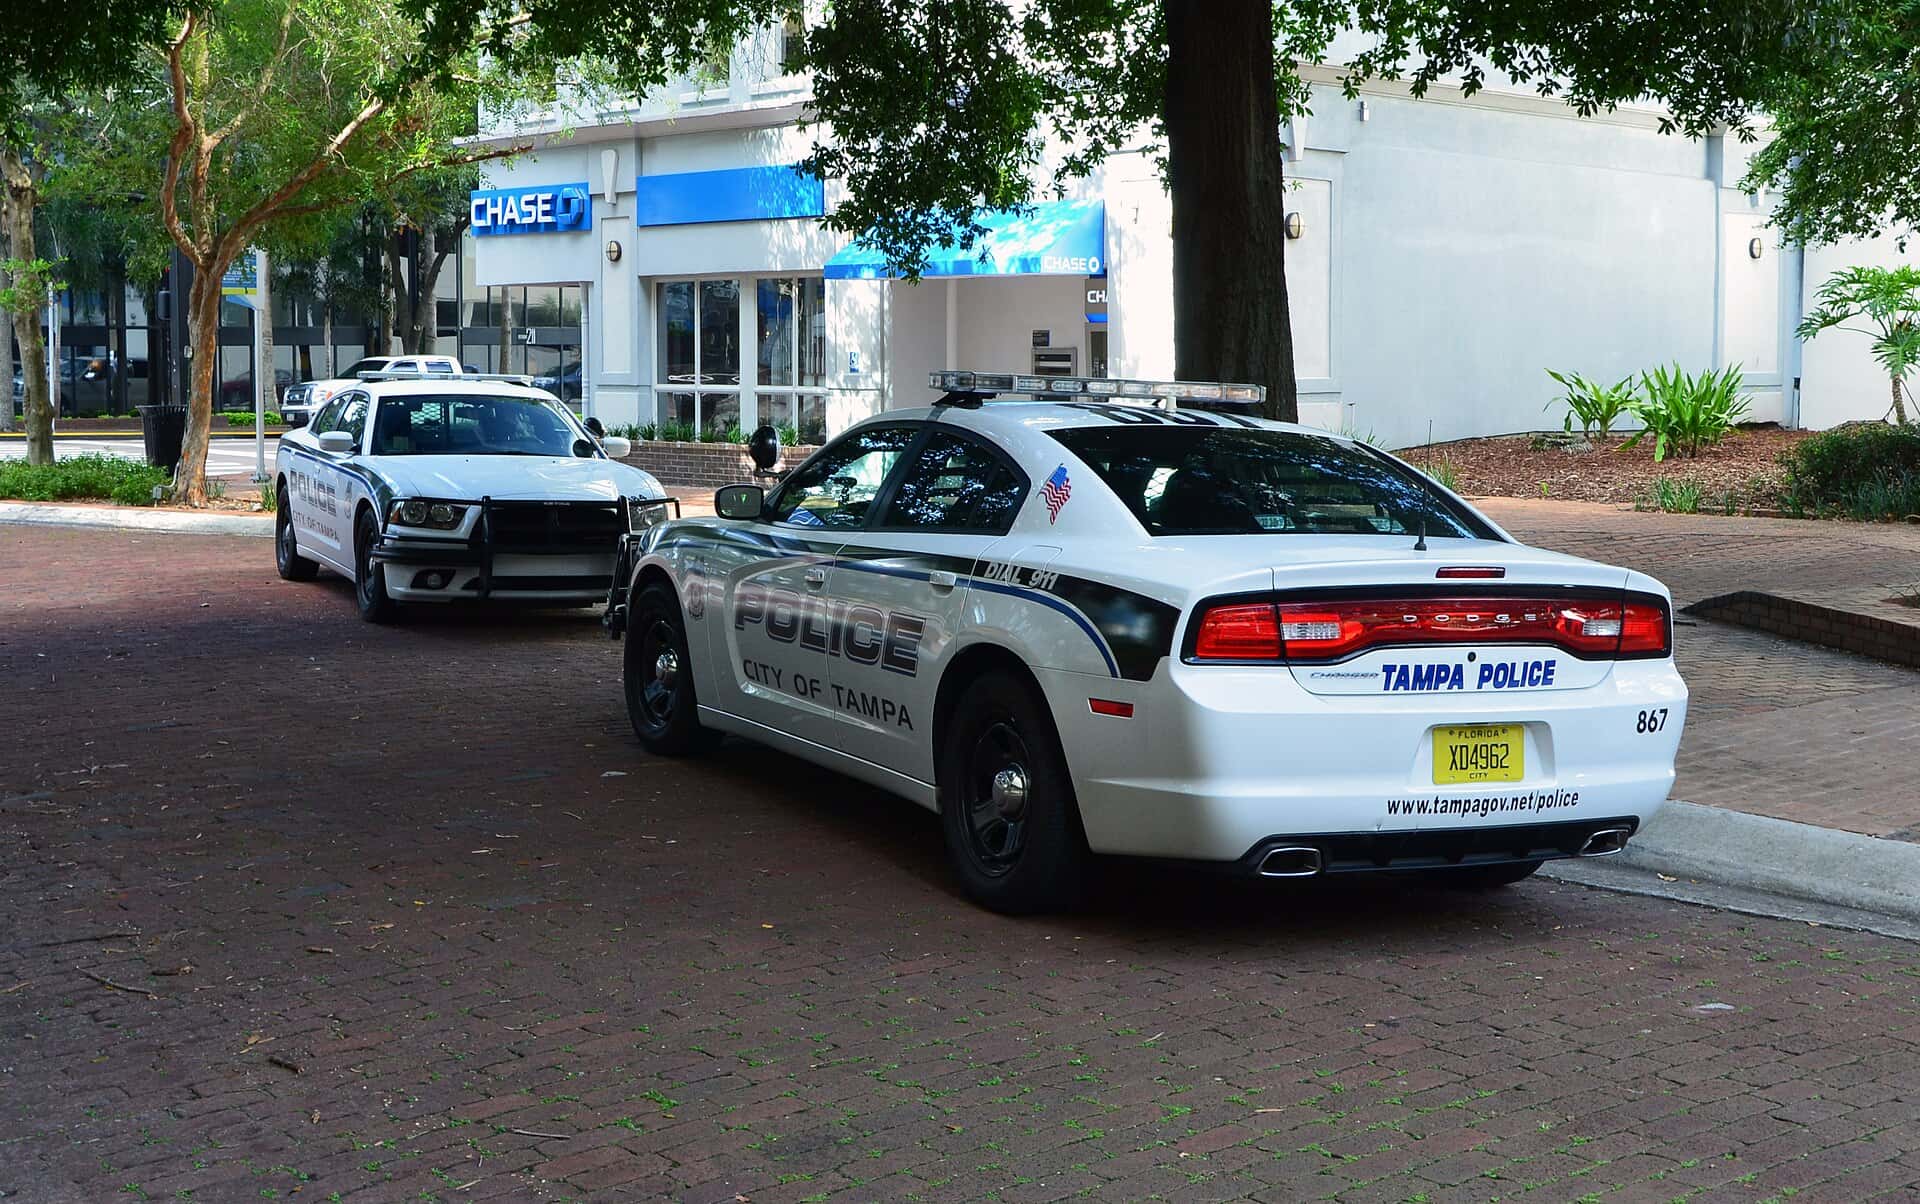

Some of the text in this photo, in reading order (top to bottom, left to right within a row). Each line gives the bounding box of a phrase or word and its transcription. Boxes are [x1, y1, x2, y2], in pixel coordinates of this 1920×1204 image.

[471, 193, 556, 226] CHASE
[1043, 256, 1087, 272] CHASE
[1087, 290, 1108, 303] CH
[290, 467, 337, 517] POLICE
[984, 561, 1059, 590] DIAL 911
[734, 582, 927, 678] POLICE
[1402, 613, 1537, 623] DODGE
[1382, 659, 1556, 691] TAMPA POLICE
[743, 659, 914, 731] CITY OF TAMPA
[1458, 729, 1500, 739] FLORIDA
[1636, 708, 1668, 734] 867
[1449, 743, 1510, 770] XD4962
[1469, 772, 1489, 780] CITY
[1387, 788, 1579, 818] www.tampagov.net/police
